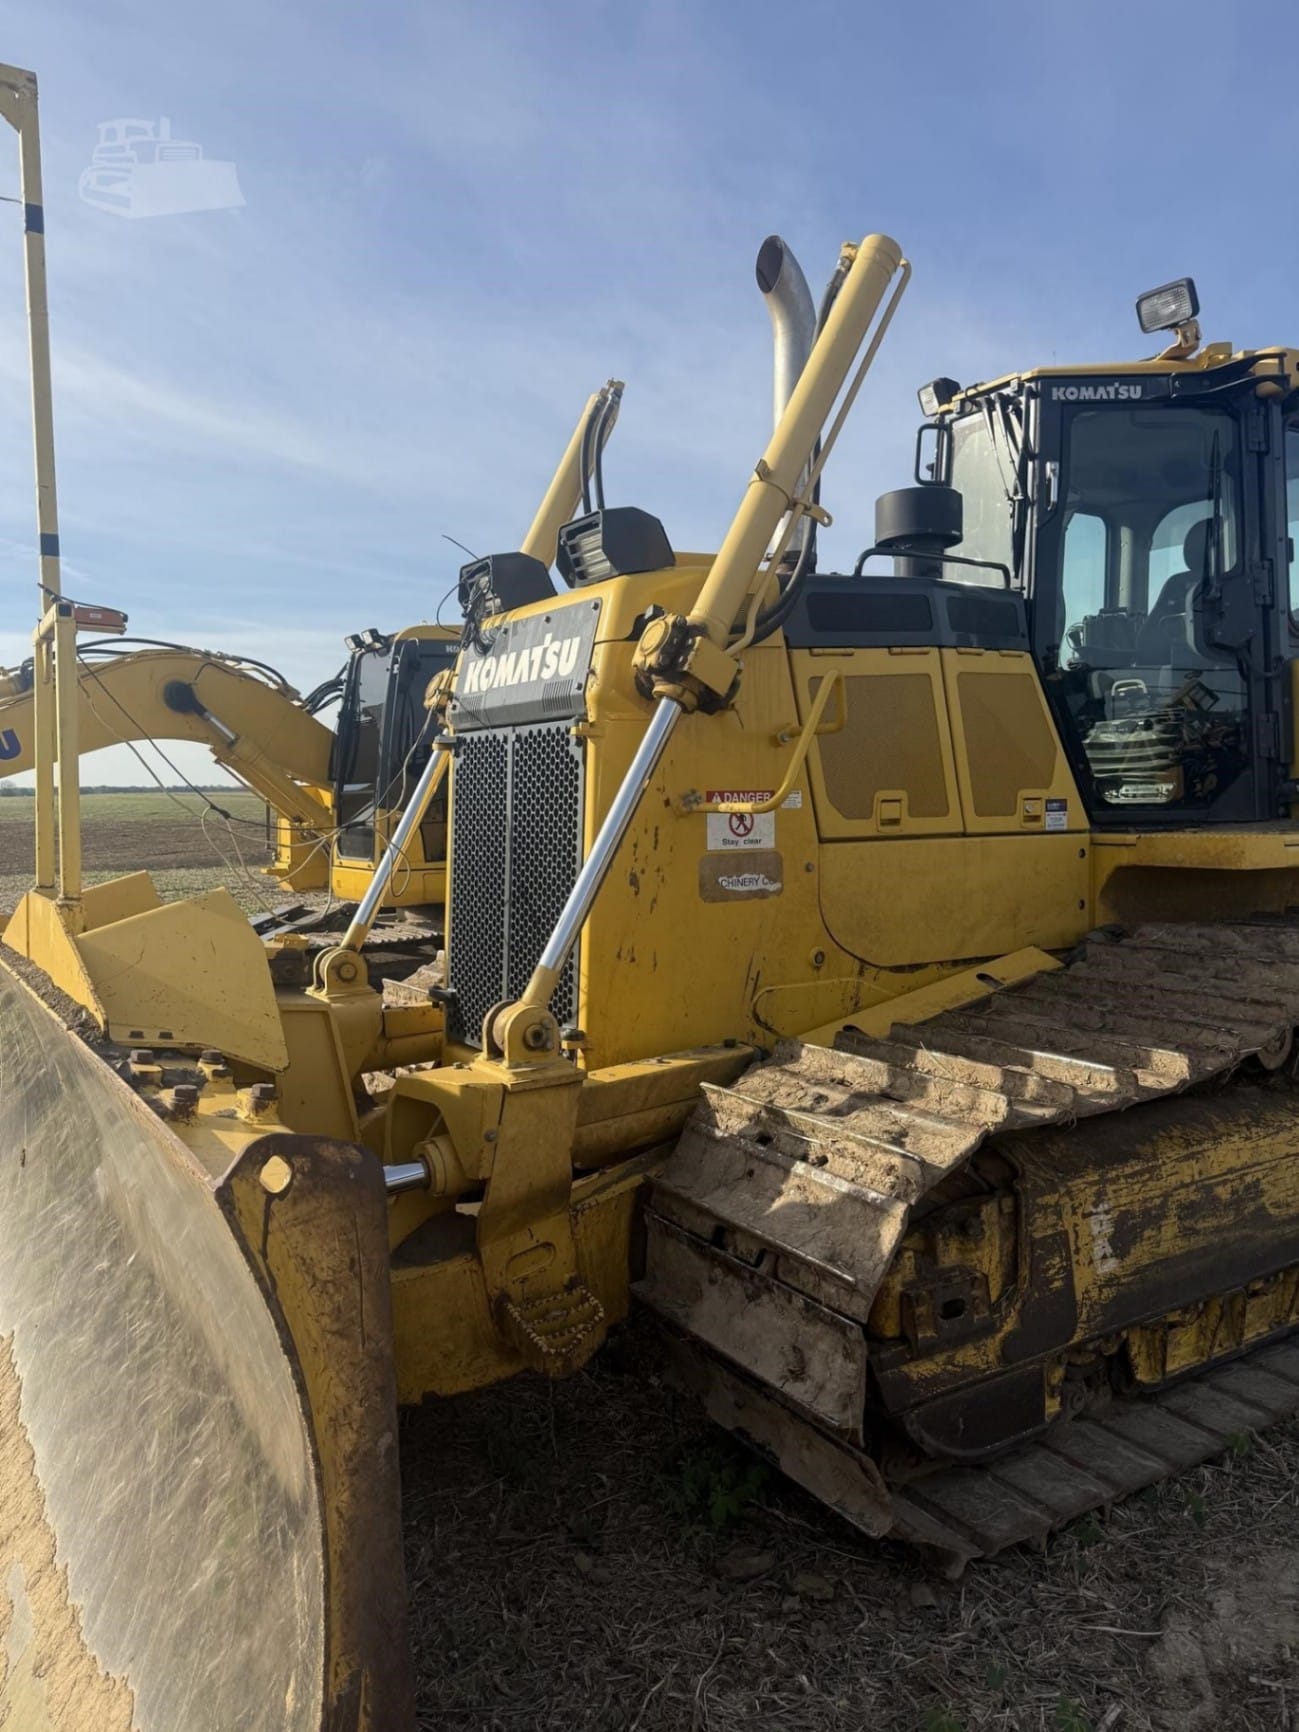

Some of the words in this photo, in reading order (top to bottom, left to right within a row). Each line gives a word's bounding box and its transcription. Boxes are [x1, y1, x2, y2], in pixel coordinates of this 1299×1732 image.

[1051, 382, 1143, 401] KOMATSU
[463, 632, 581, 694] KOMATSU
[723, 792, 772, 803] DANGER
[722, 838, 739, 847] Stay
[743, 837, 763, 845] clear
